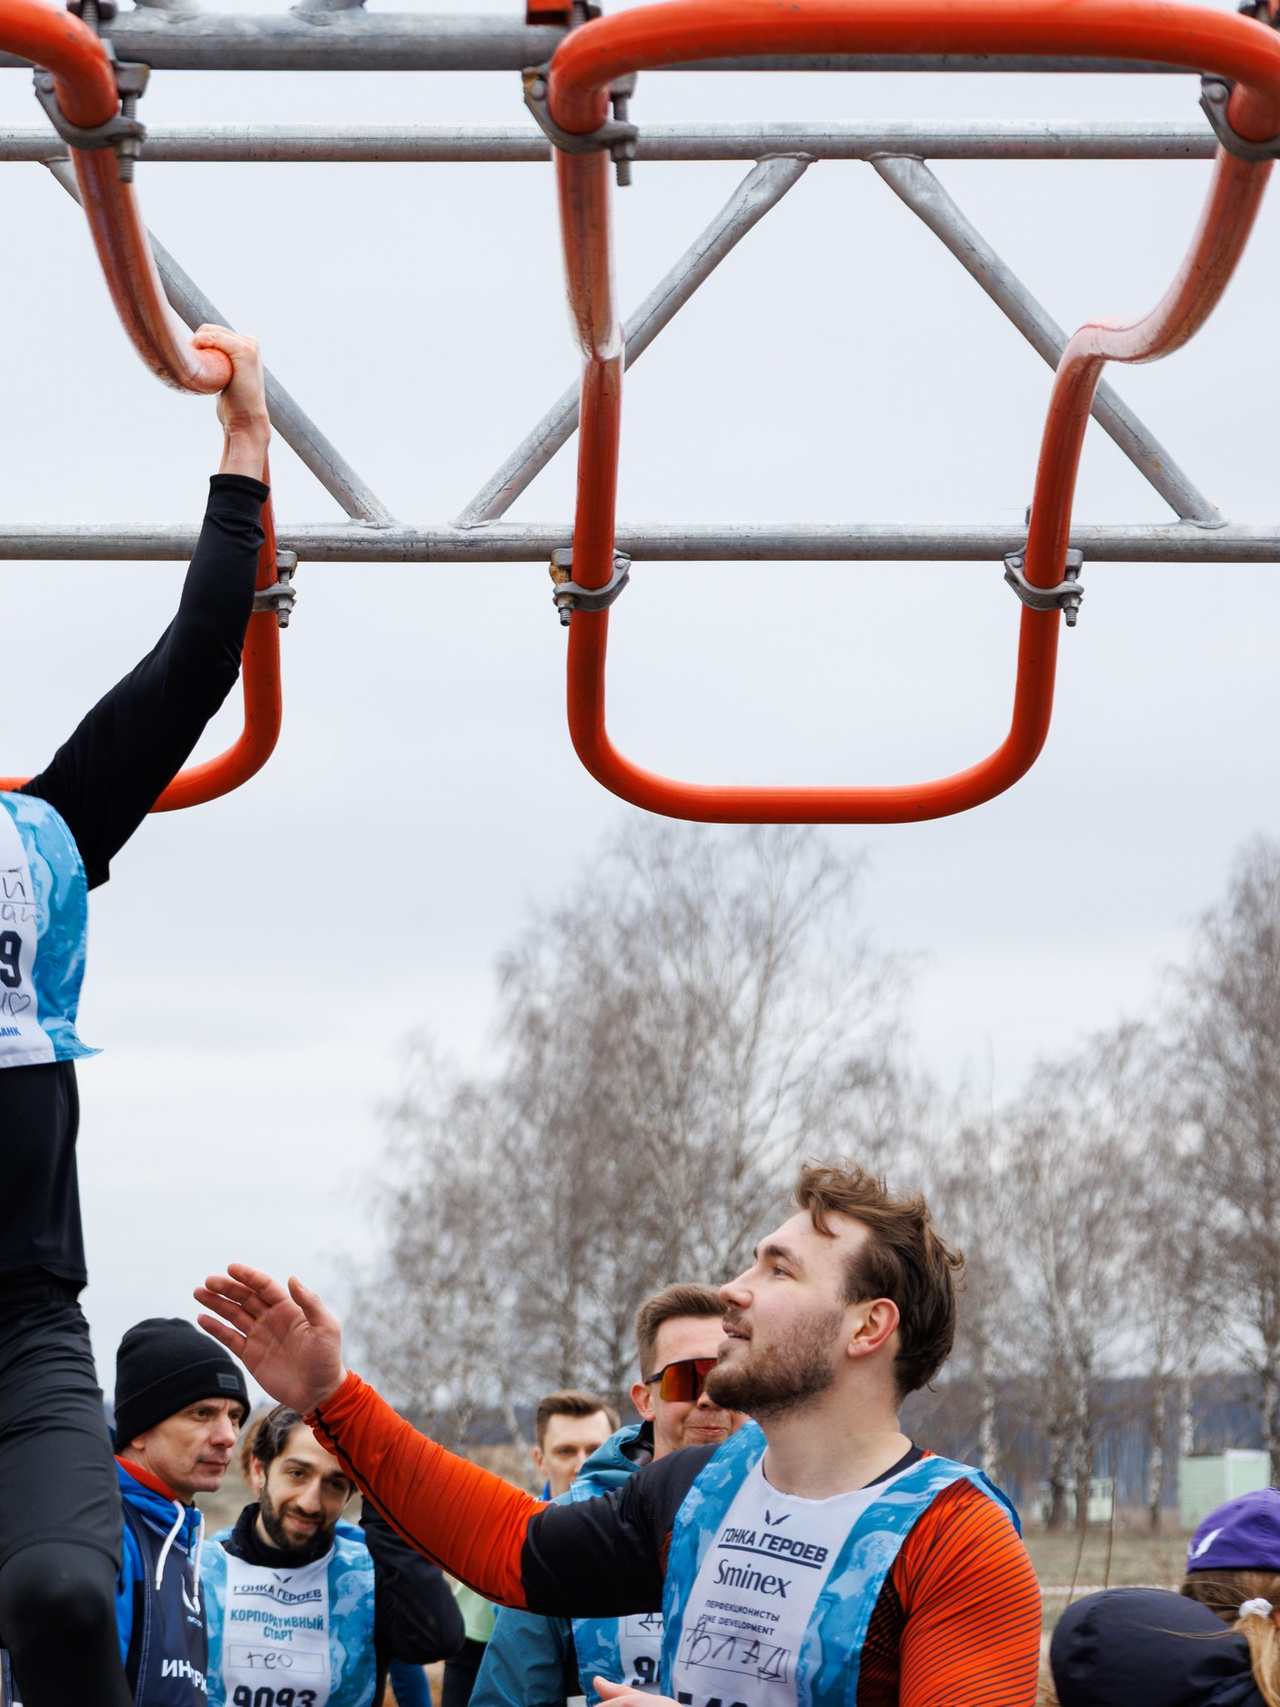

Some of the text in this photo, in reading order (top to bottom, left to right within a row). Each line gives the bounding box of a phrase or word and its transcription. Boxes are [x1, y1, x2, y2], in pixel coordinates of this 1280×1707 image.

[720, 1528, 829, 1563] ГОНКА ГЕРОЕВ
[713, 1559, 792, 1598] Sminex
[233, 1584, 322, 1602] ГОНКА ГЕРОЕВ
[230, 1609, 324, 1631] КОРПОРАТИВНЫЙ
[704, 1599, 781, 1623] ПЕРФЕКЦИОНИСТЫ
[263, 1626, 293, 1641] СТАРТ
[717, 1616, 776, 1636] DEVELOPMENT
